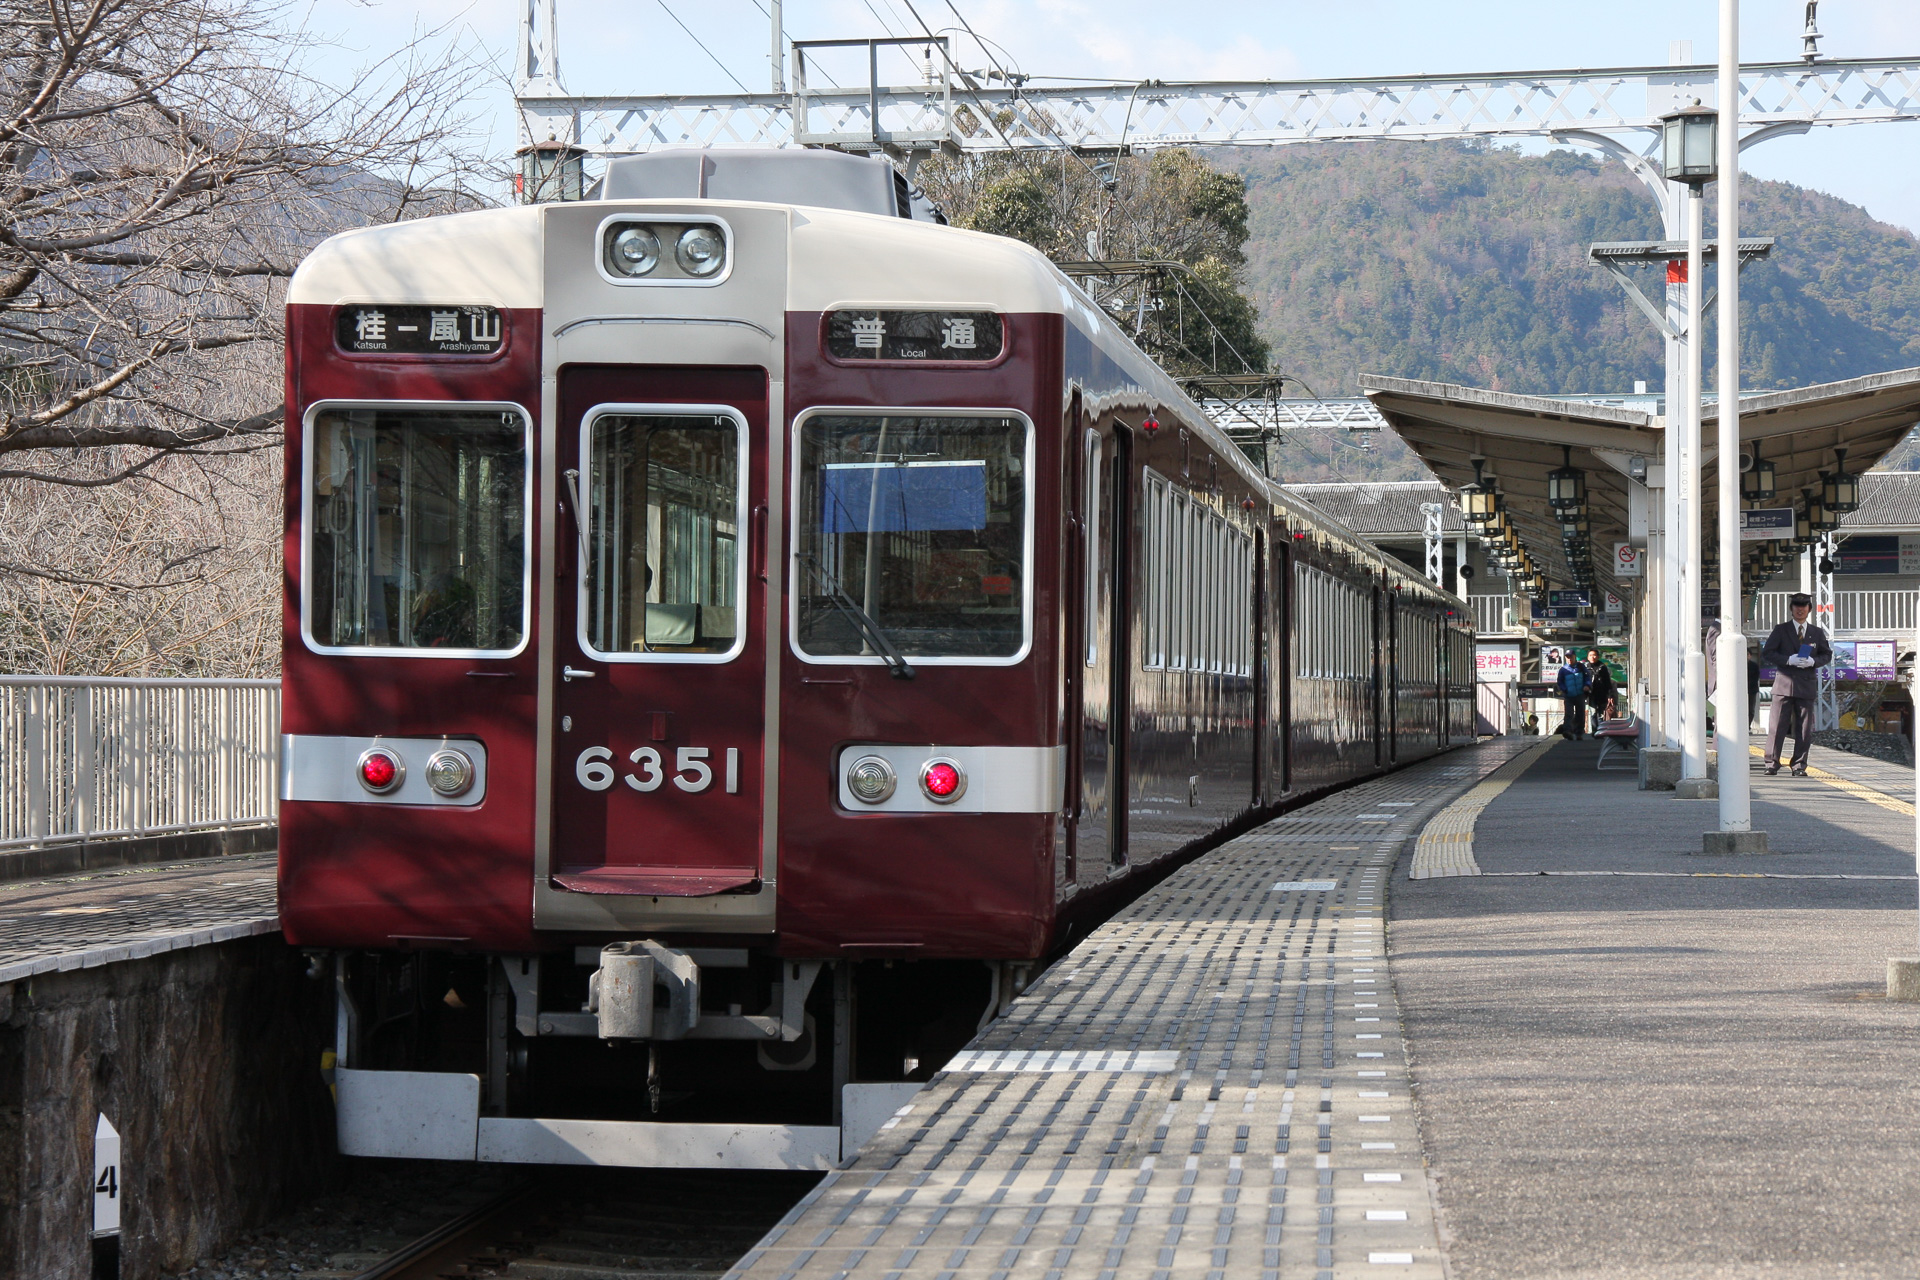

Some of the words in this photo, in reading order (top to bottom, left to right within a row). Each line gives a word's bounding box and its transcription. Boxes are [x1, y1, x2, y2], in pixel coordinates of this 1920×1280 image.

[851, 317, 977, 350] 普通
[353, 341, 387, 350] Katsura
[439, 341, 490, 352] Arashiyama
[901, 349, 926, 358] Local
[576, 745, 738, 793] 6351
[96, 1165, 118, 1199] 4
